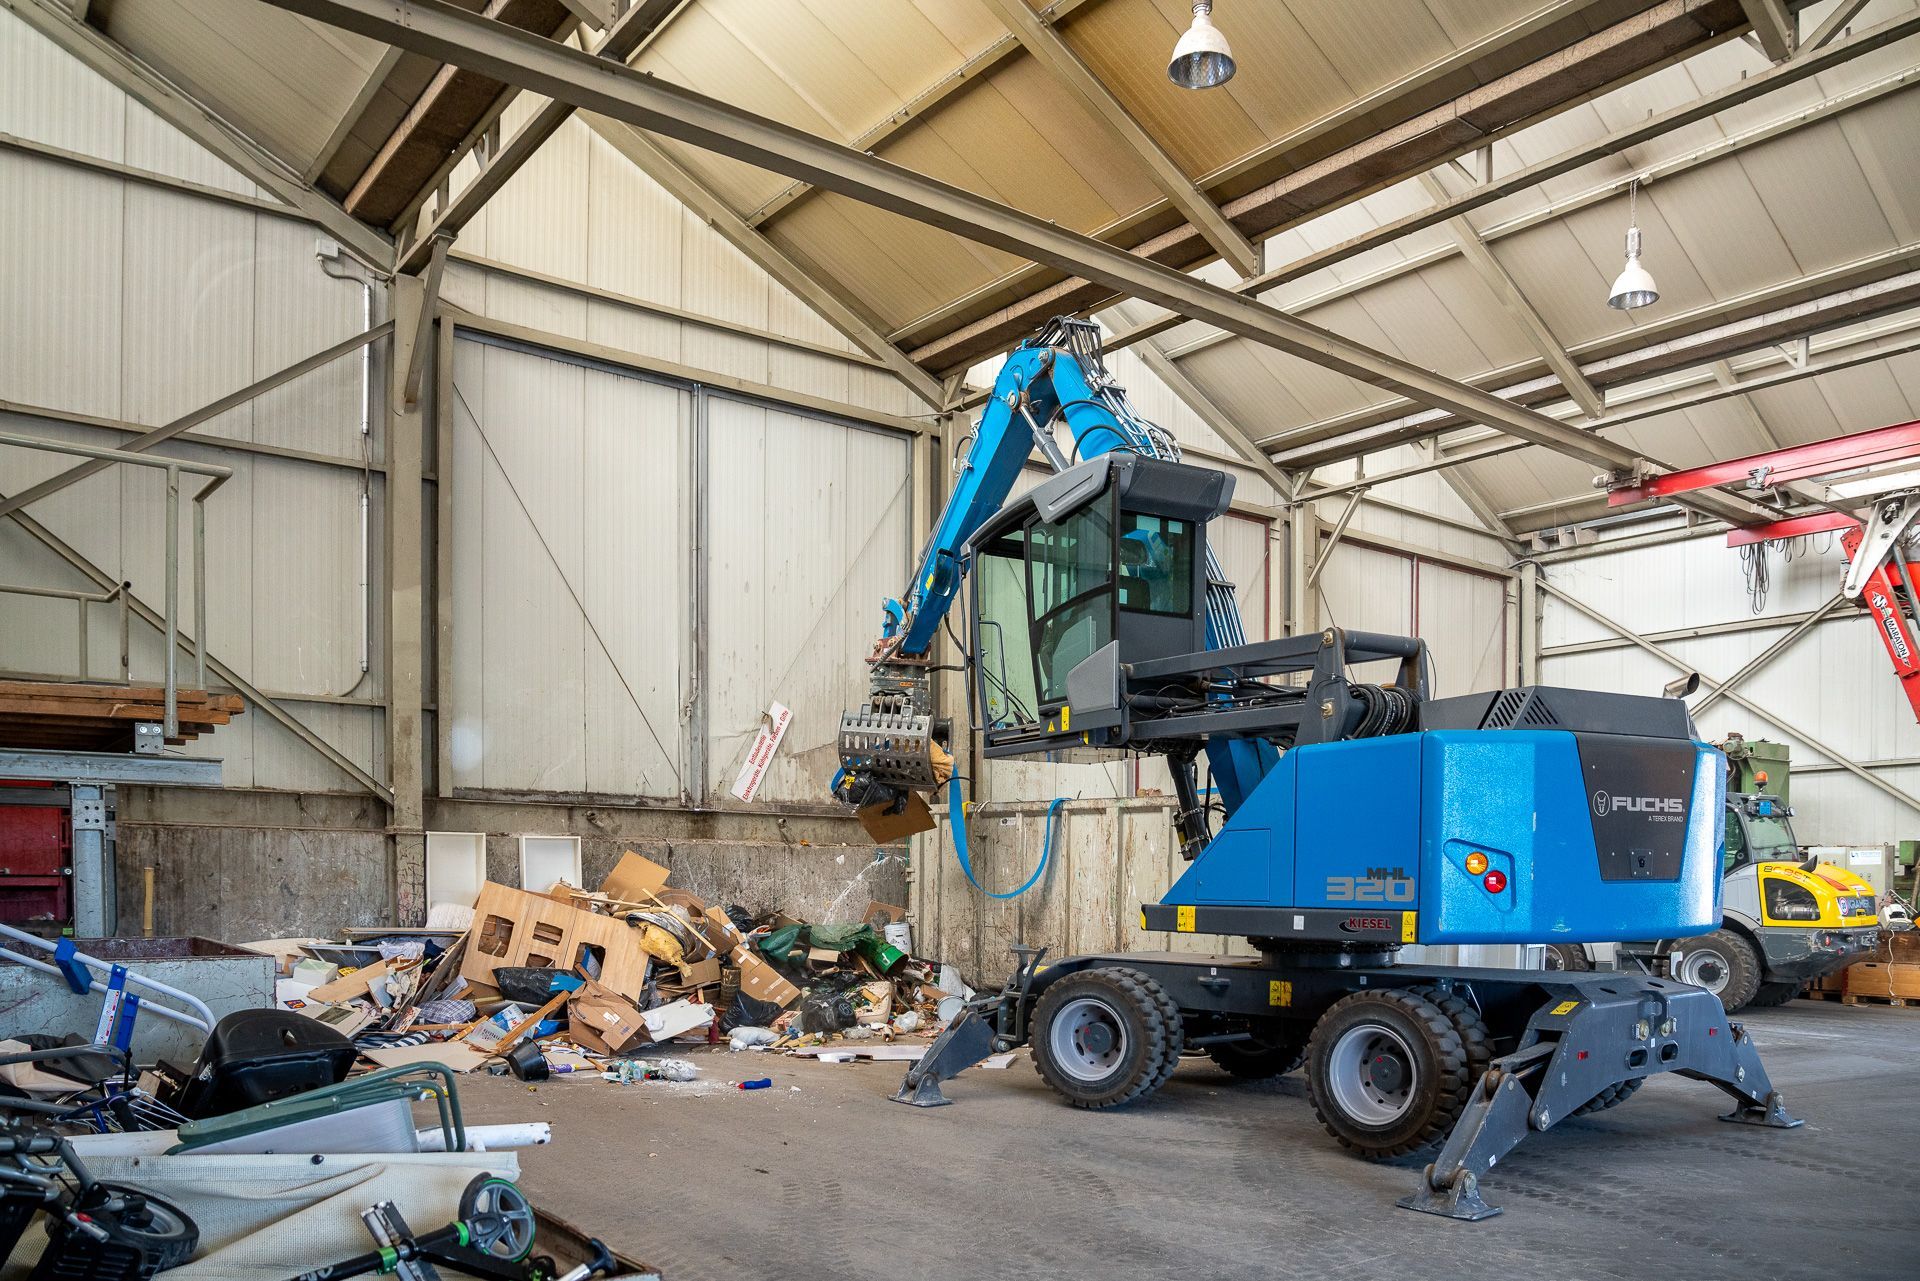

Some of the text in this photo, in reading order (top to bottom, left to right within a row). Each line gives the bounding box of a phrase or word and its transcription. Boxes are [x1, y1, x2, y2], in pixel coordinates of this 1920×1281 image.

[1887, 620, 1908, 657] MARATON
[1612, 796, 1683, 813] FUCHS
[1367, 867, 1410, 880] MHL
[1327, 877, 1415, 901] 320
[1349, 918, 1392, 930] KIESEL
